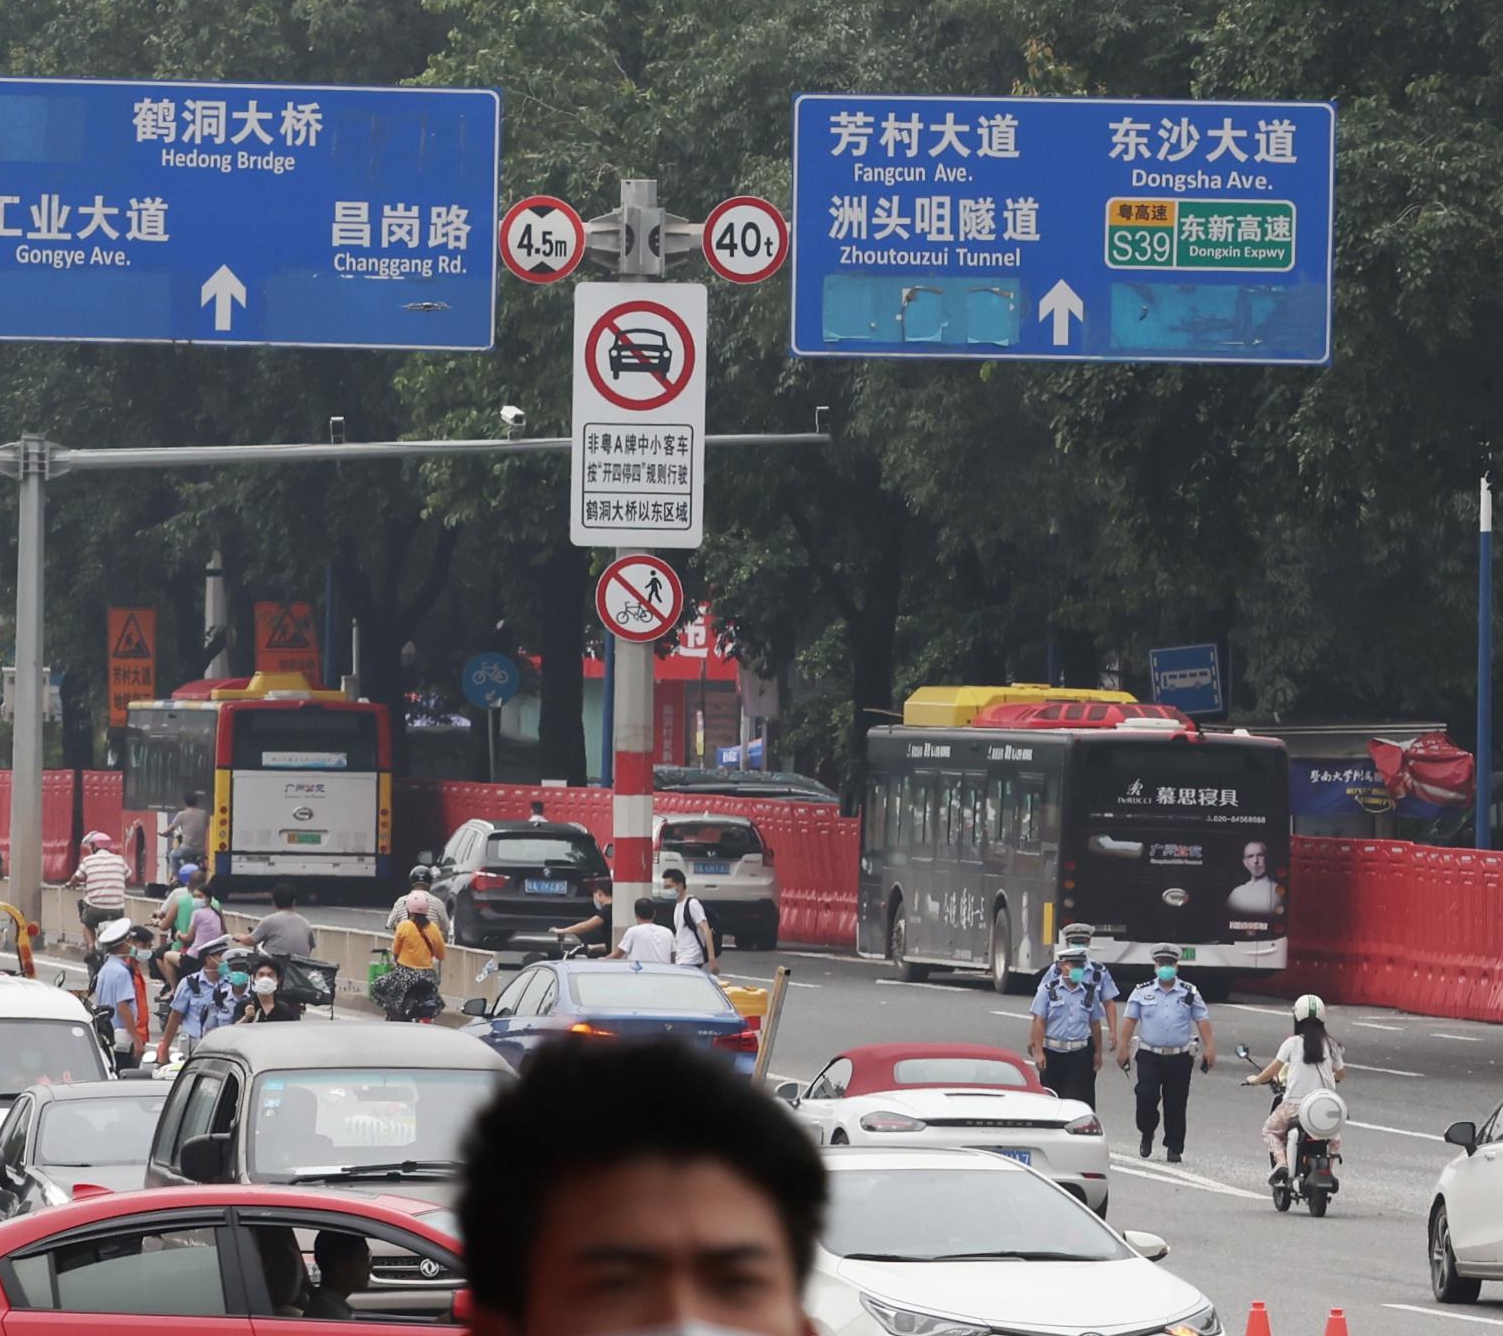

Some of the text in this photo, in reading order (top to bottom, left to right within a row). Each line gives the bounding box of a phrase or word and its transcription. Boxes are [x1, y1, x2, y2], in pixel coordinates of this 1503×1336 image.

[133, 98, 323, 147] 鹤洞大桥
[829, 112, 1020, 158] 芳村大道
[1108, 117, 1297, 163] 东沙大道
[161, 149, 295, 174] Hedong Bridge
[854, 163, 973, 186] Fangcun Ave.
[1132, 169, 1273, 191] Dongsha Ave.
[829, 195, 1040, 241] 洲头咀隧道
[1118, 204, 1167, 221] 粤高速
[331, 201, 472, 250] 昌岗路
[1180, 214, 1292, 242] 东新高速
[517, 223, 567, 257] 4.5m
[1112, 230, 1170, 262] S39
[16, 245, 131, 268] Gongye Ave.
[840, 246, 1020, 267] Zhoutouzui Tunnel
[1189, 245, 1285, 260] Dongxin Expwy
[334, 253, 467, 277] Changgang Rd.
[587, 433, 689, 456] 非粤A牌中小客车
[586, 499, 688, 523] 鹤洞大桥以东区域
